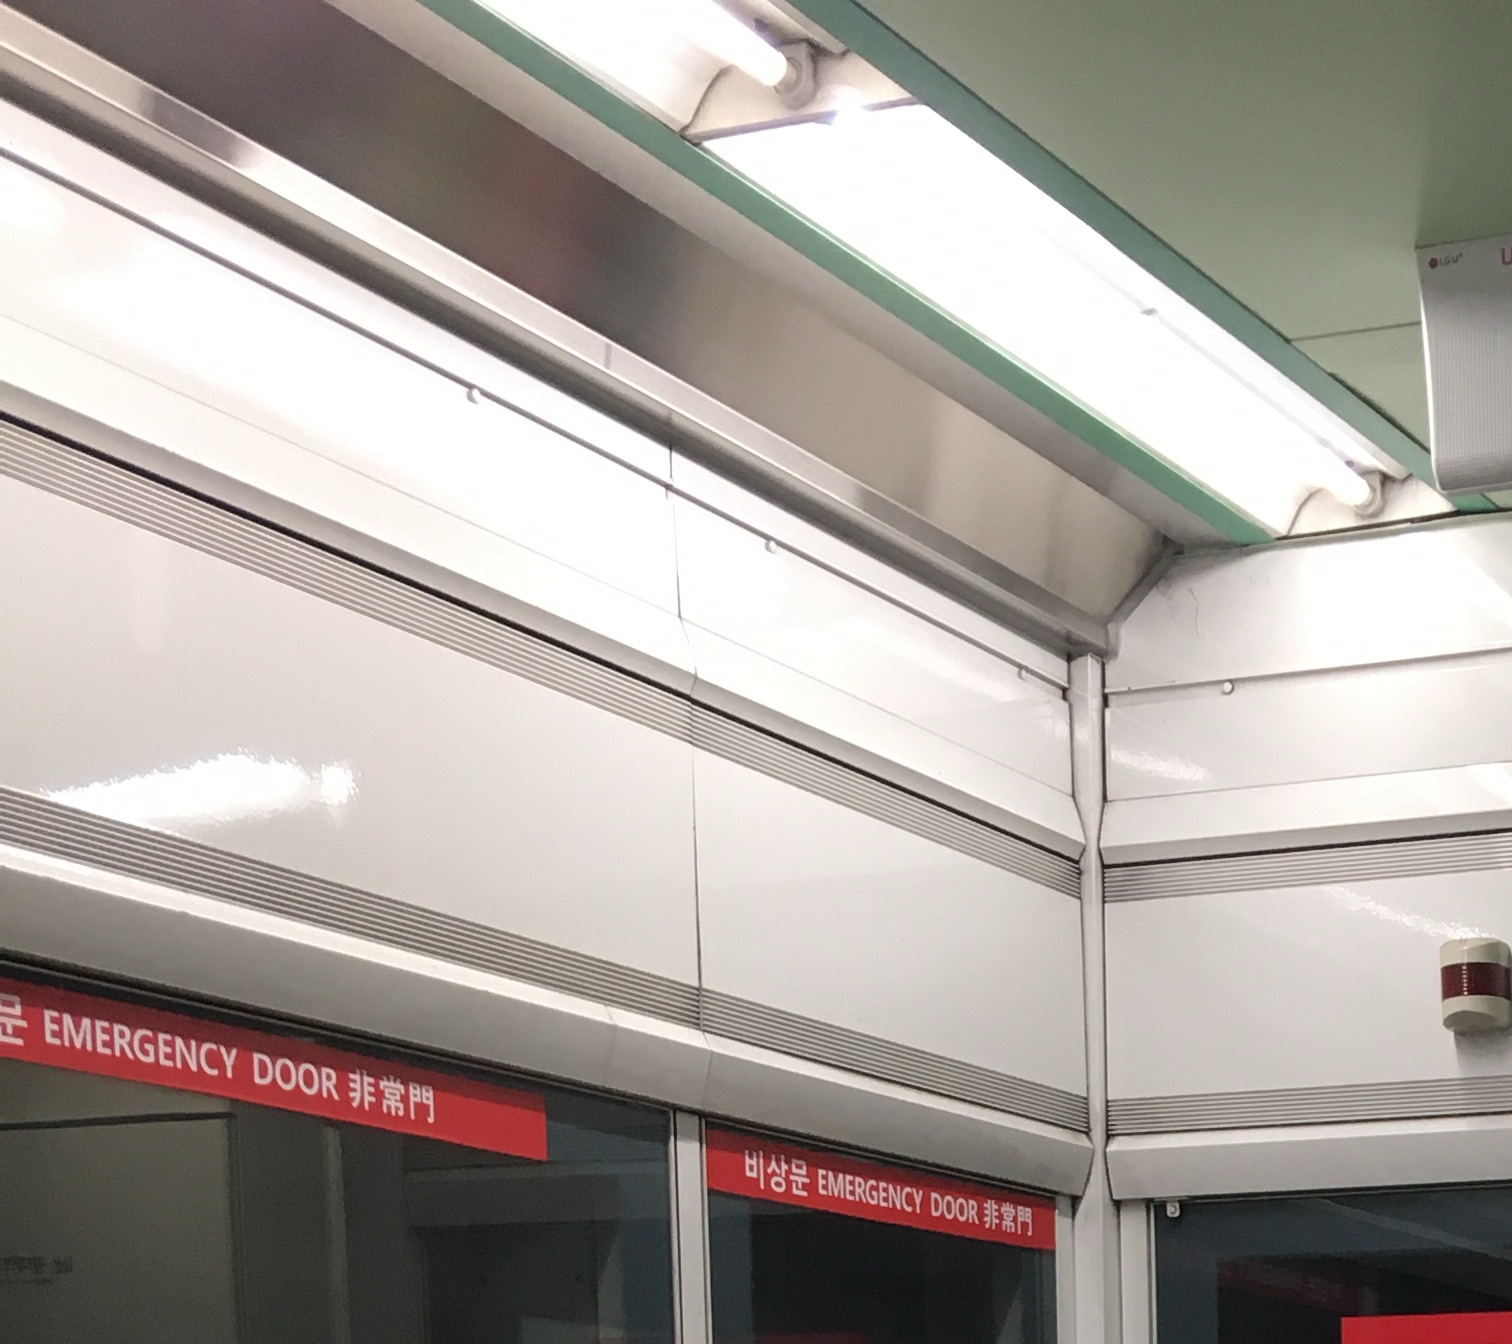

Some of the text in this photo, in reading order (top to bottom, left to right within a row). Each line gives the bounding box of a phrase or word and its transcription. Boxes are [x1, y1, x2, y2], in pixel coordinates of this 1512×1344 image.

[44, 1009, 237, 1080] EMERGENCY
[252, 1053, 340, 1102] DOOR
[348, 1069, 436, 1124] 非常門
[745, 1149, 1034, 1237] 비상문 EMERGENCY DOOR 非常門
